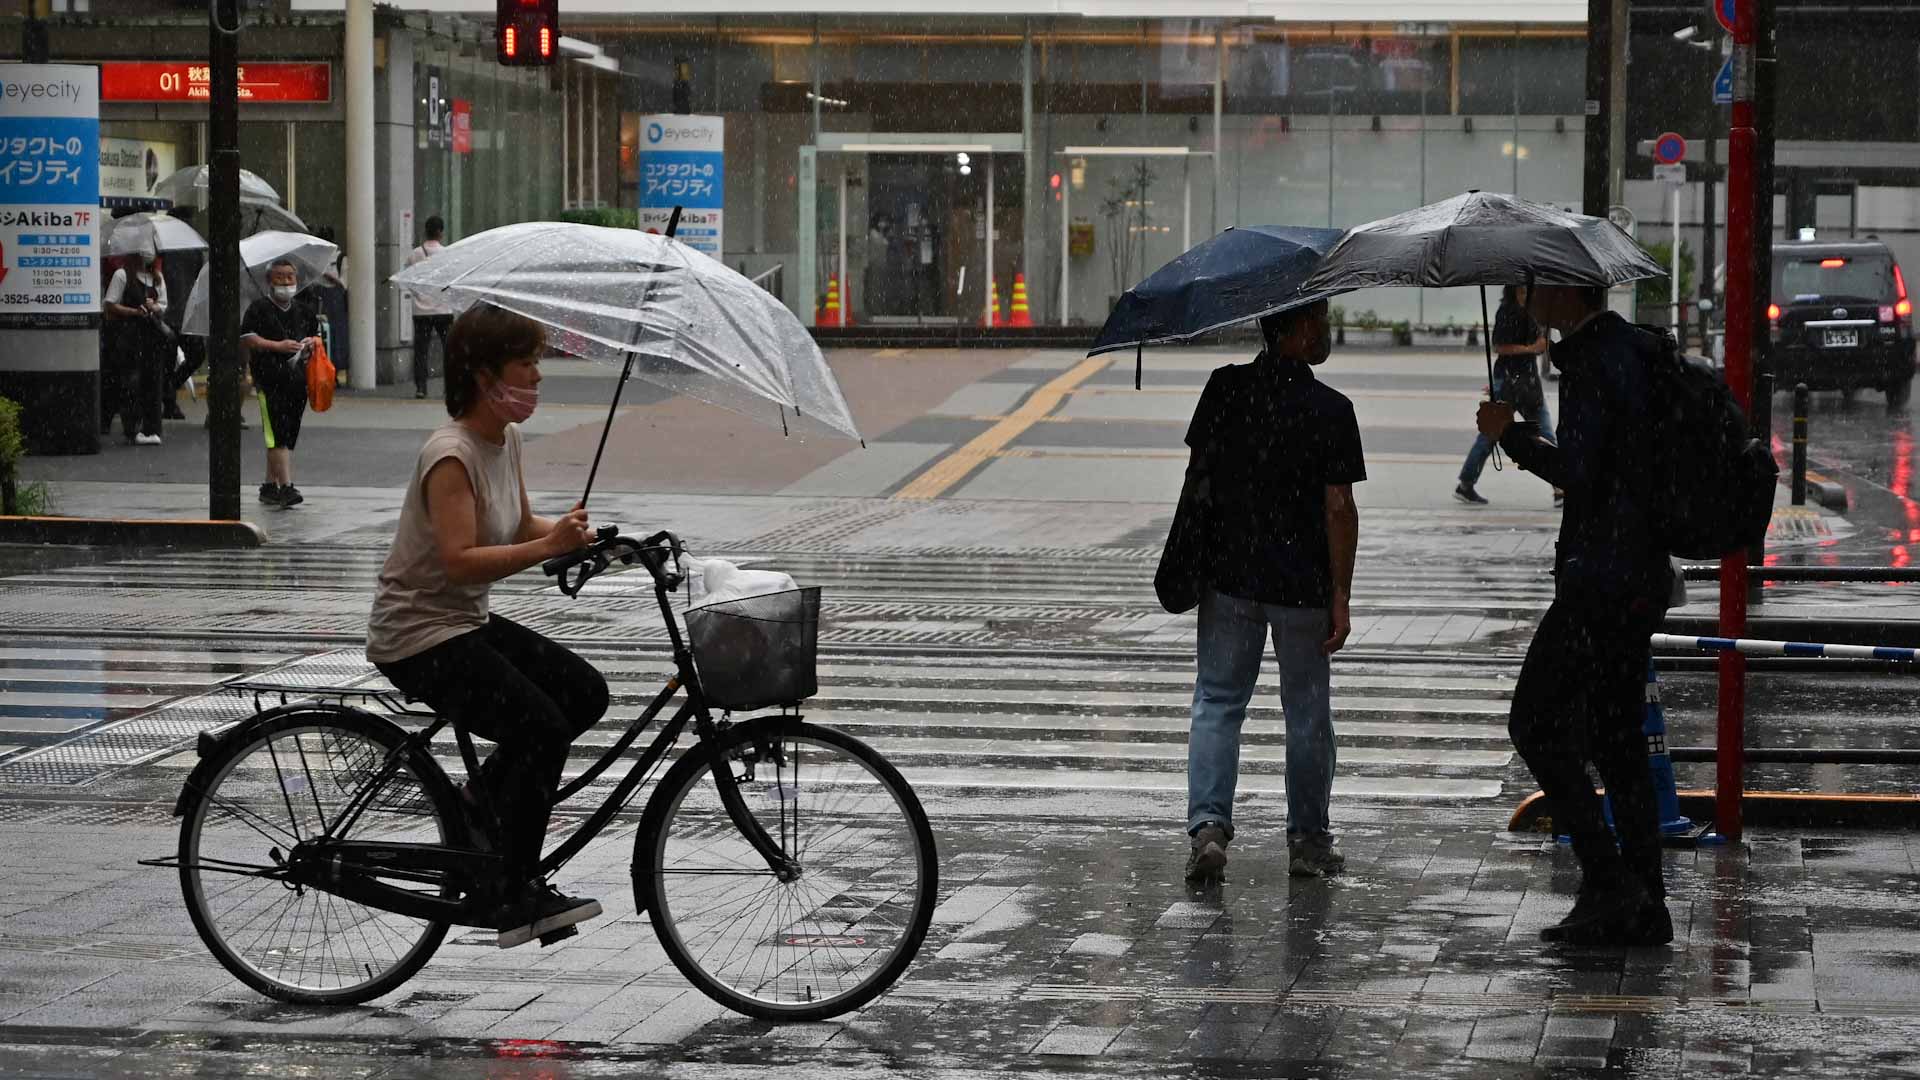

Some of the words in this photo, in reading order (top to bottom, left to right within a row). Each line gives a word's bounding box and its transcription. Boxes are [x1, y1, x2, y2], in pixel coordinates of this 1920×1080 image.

[6, 79, 81, 103] eyecity
[160, 73, 180, 91] 01
[664, 124, 714, 143] eyecity
[647, 164, 714, 177] コンタクトの
[647, 179, 713, 197] アイシティ
